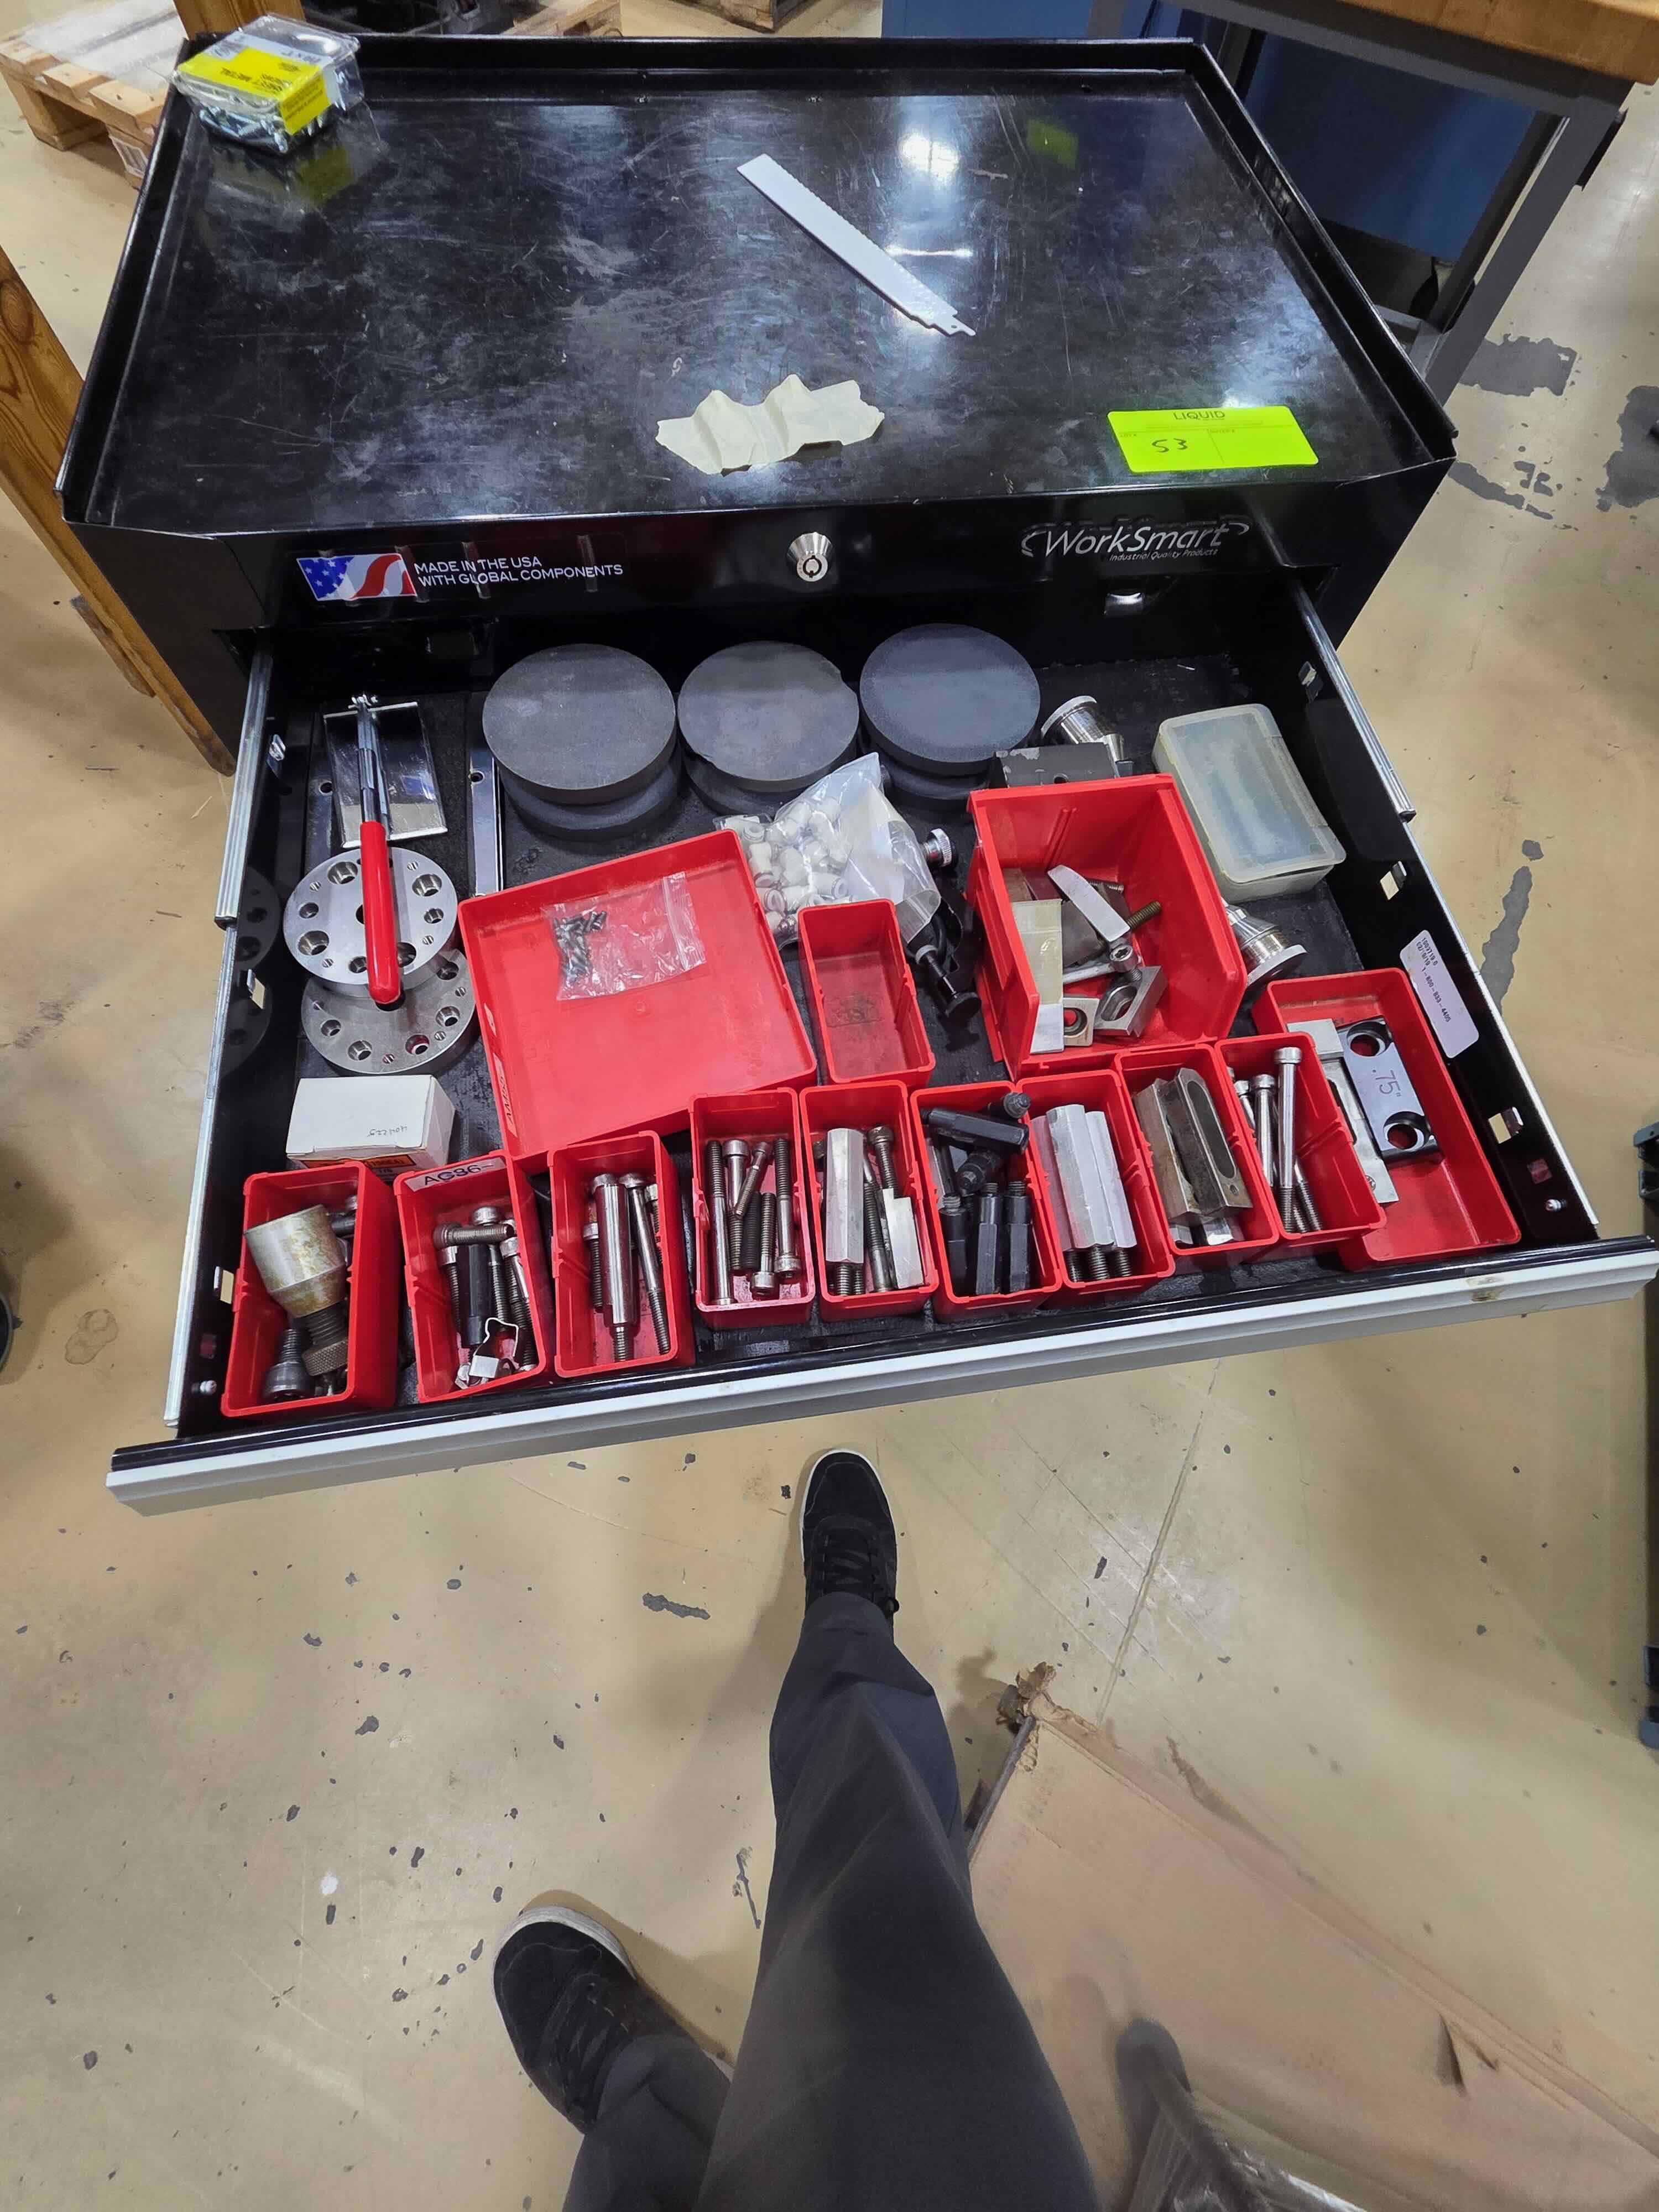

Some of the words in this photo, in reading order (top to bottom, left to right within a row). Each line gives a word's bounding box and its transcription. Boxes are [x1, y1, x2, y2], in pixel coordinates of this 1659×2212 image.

[1173, 410, 1225, 421] LIQUID
[1045, 524, 1229, 556] WorkSmart
[414, 560, 460, 575] MADE
[462, 559, 477, 573] IN
[477, 557, 508, 572] THE
[512, 556, 542, 570] USA
[1109, 552, 1151, 562] Industrial
[1151, 551, 1182, 560] Quality
[418, 573, 457, 587] WITH
[458, 569, 519, 585] GLOBAL
[521, 564, 623, 581] COMPONENTS
